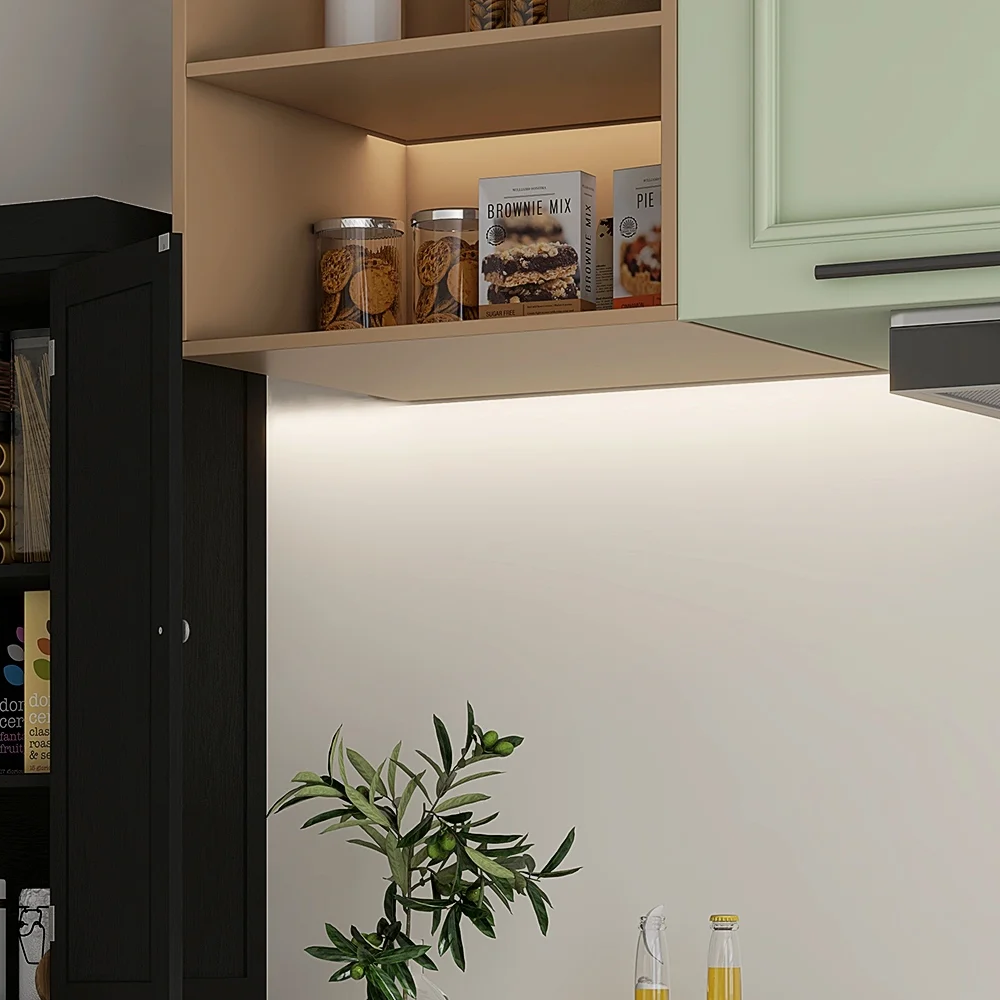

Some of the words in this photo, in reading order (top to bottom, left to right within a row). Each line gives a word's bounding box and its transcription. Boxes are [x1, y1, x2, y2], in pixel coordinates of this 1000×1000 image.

[487, 200, 543, 219] BROWNIE
[549, 198, 571, 214] MIX
[637, 192, 654, 209] PIE
[29, 750, 39, 760] &
